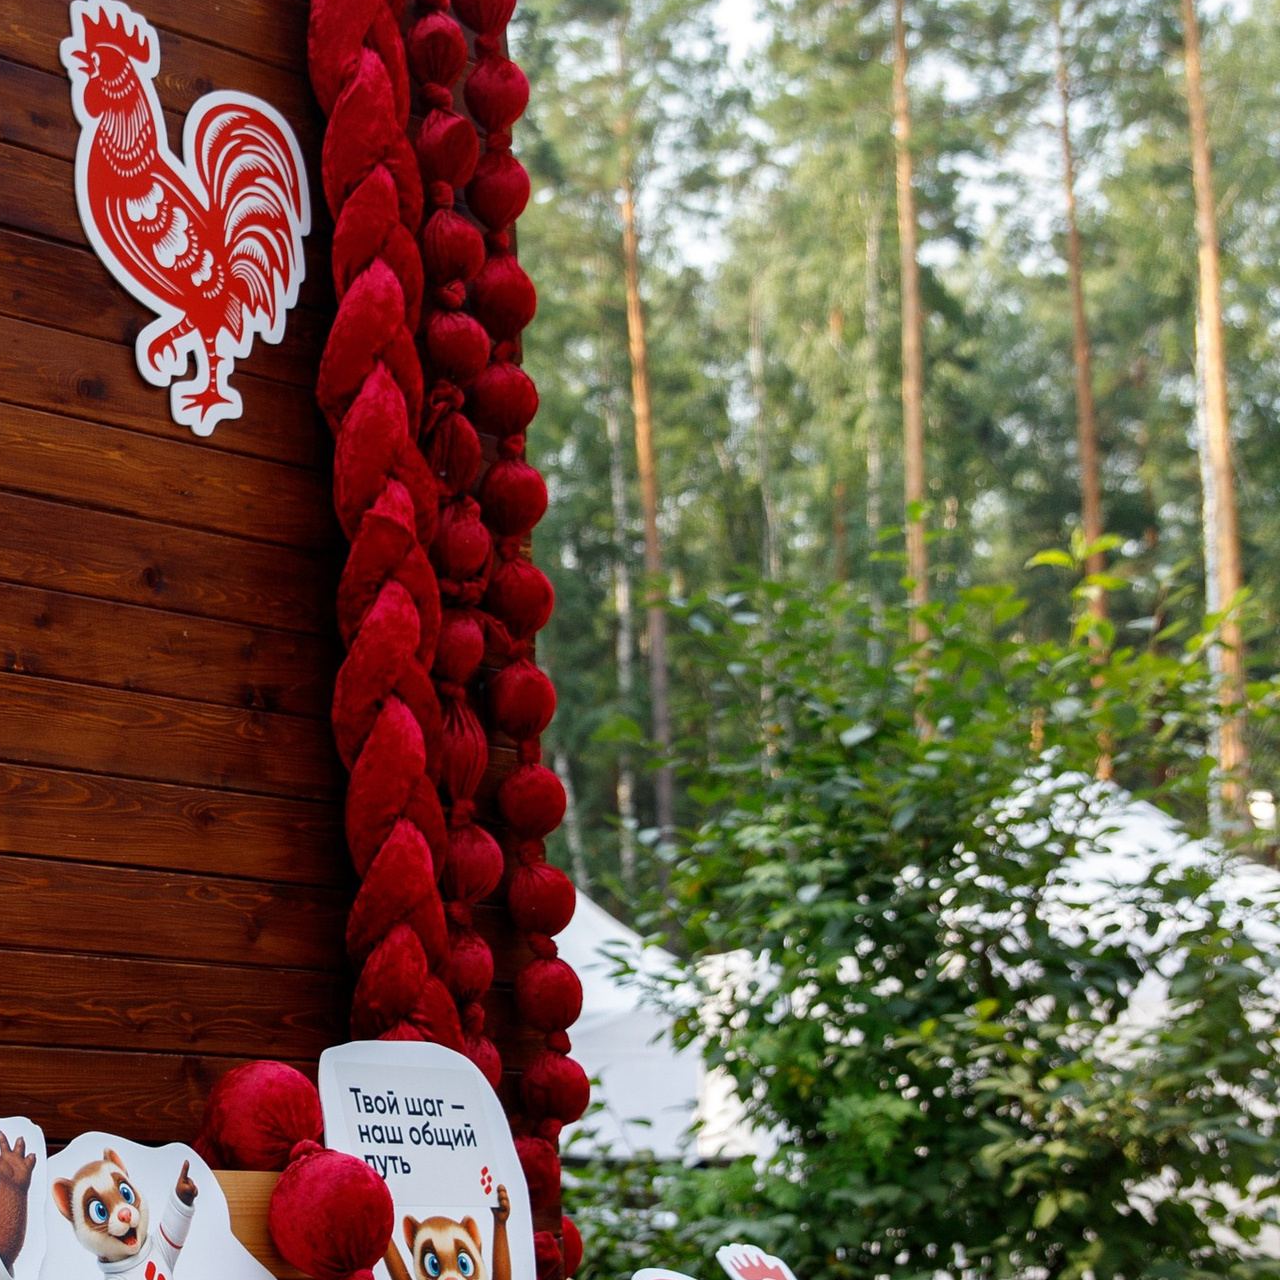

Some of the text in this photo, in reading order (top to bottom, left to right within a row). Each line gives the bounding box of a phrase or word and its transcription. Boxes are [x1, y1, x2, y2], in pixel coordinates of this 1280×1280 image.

[349, 1087, 400, 1115] Твой
[404, 1096, 444, 1117] шаг
[358, 1121, 477, 1151] наш общий
